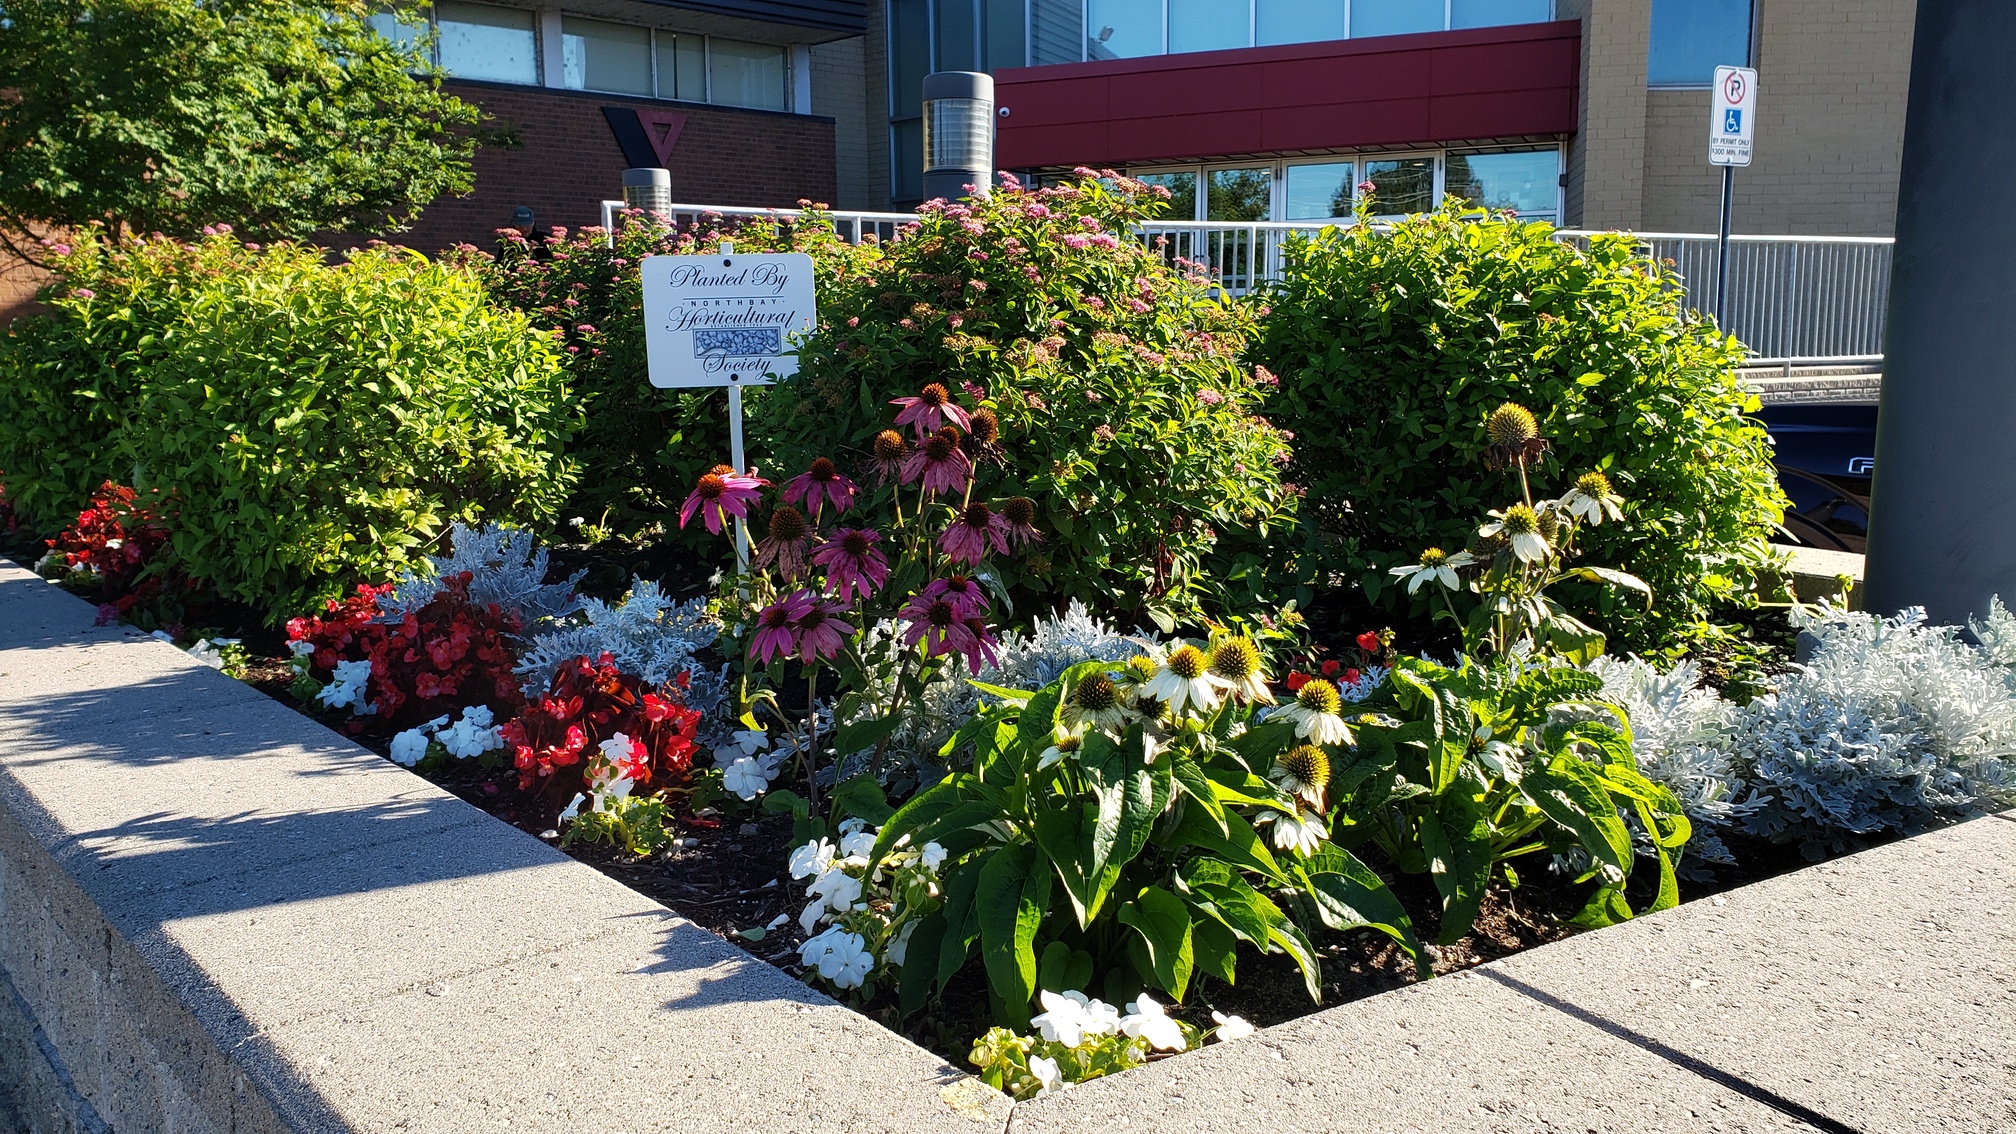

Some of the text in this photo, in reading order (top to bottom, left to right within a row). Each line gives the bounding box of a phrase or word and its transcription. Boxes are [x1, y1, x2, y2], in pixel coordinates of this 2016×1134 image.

[1712, 137, 1719, 145] BY
[1720, 137, 1737, 146] PERMIT
[670, 262, 790, 295] Planted By
[665, 306, 796, 332] Horticultural
[702, 352, 773, 381] Society
